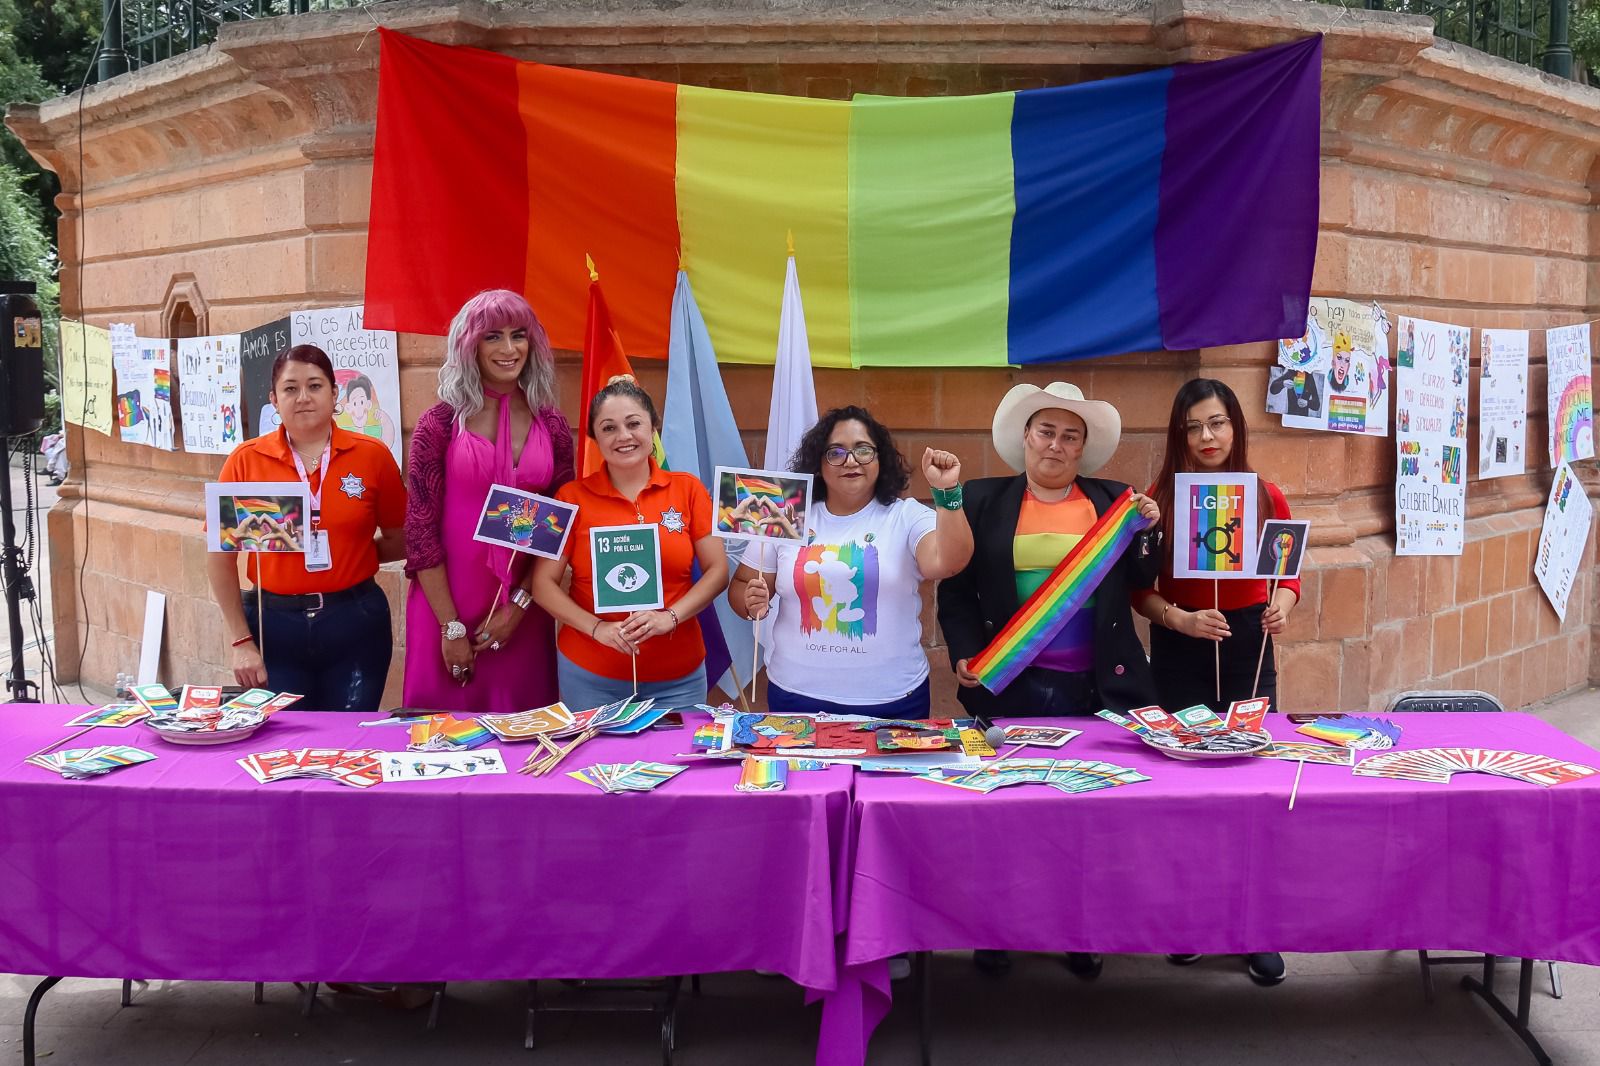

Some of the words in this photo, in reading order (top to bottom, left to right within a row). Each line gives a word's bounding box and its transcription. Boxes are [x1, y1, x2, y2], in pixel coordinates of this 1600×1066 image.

[1325, 299, 1346, 322] hay
[296, 315, 313, 337] Si
[320, 316, 339, 335] es
[348, 311, 364, 333] AM
[241, 333, 270, 359] AMOR
[275, 330, 287, 352] ES
[327, 334, 390, 352] necesita
[1421, 331, 1435, 361] YO
[332, 351, 390, 368] licación.
[1192, 495, 1242, 510] LGBT
[1432, 484, 1460, 517] BAKER
[597, 537, 610, 553] 13
[613, 545, 624, 553] POR
[624, 544, 630, 552] EL
[630, 543, 645, 552] CLIMA
[806, 643, 827, 653] LOVE
[829, 645, 848, 654] FOR
[850, 645, 867, 654] ALL
